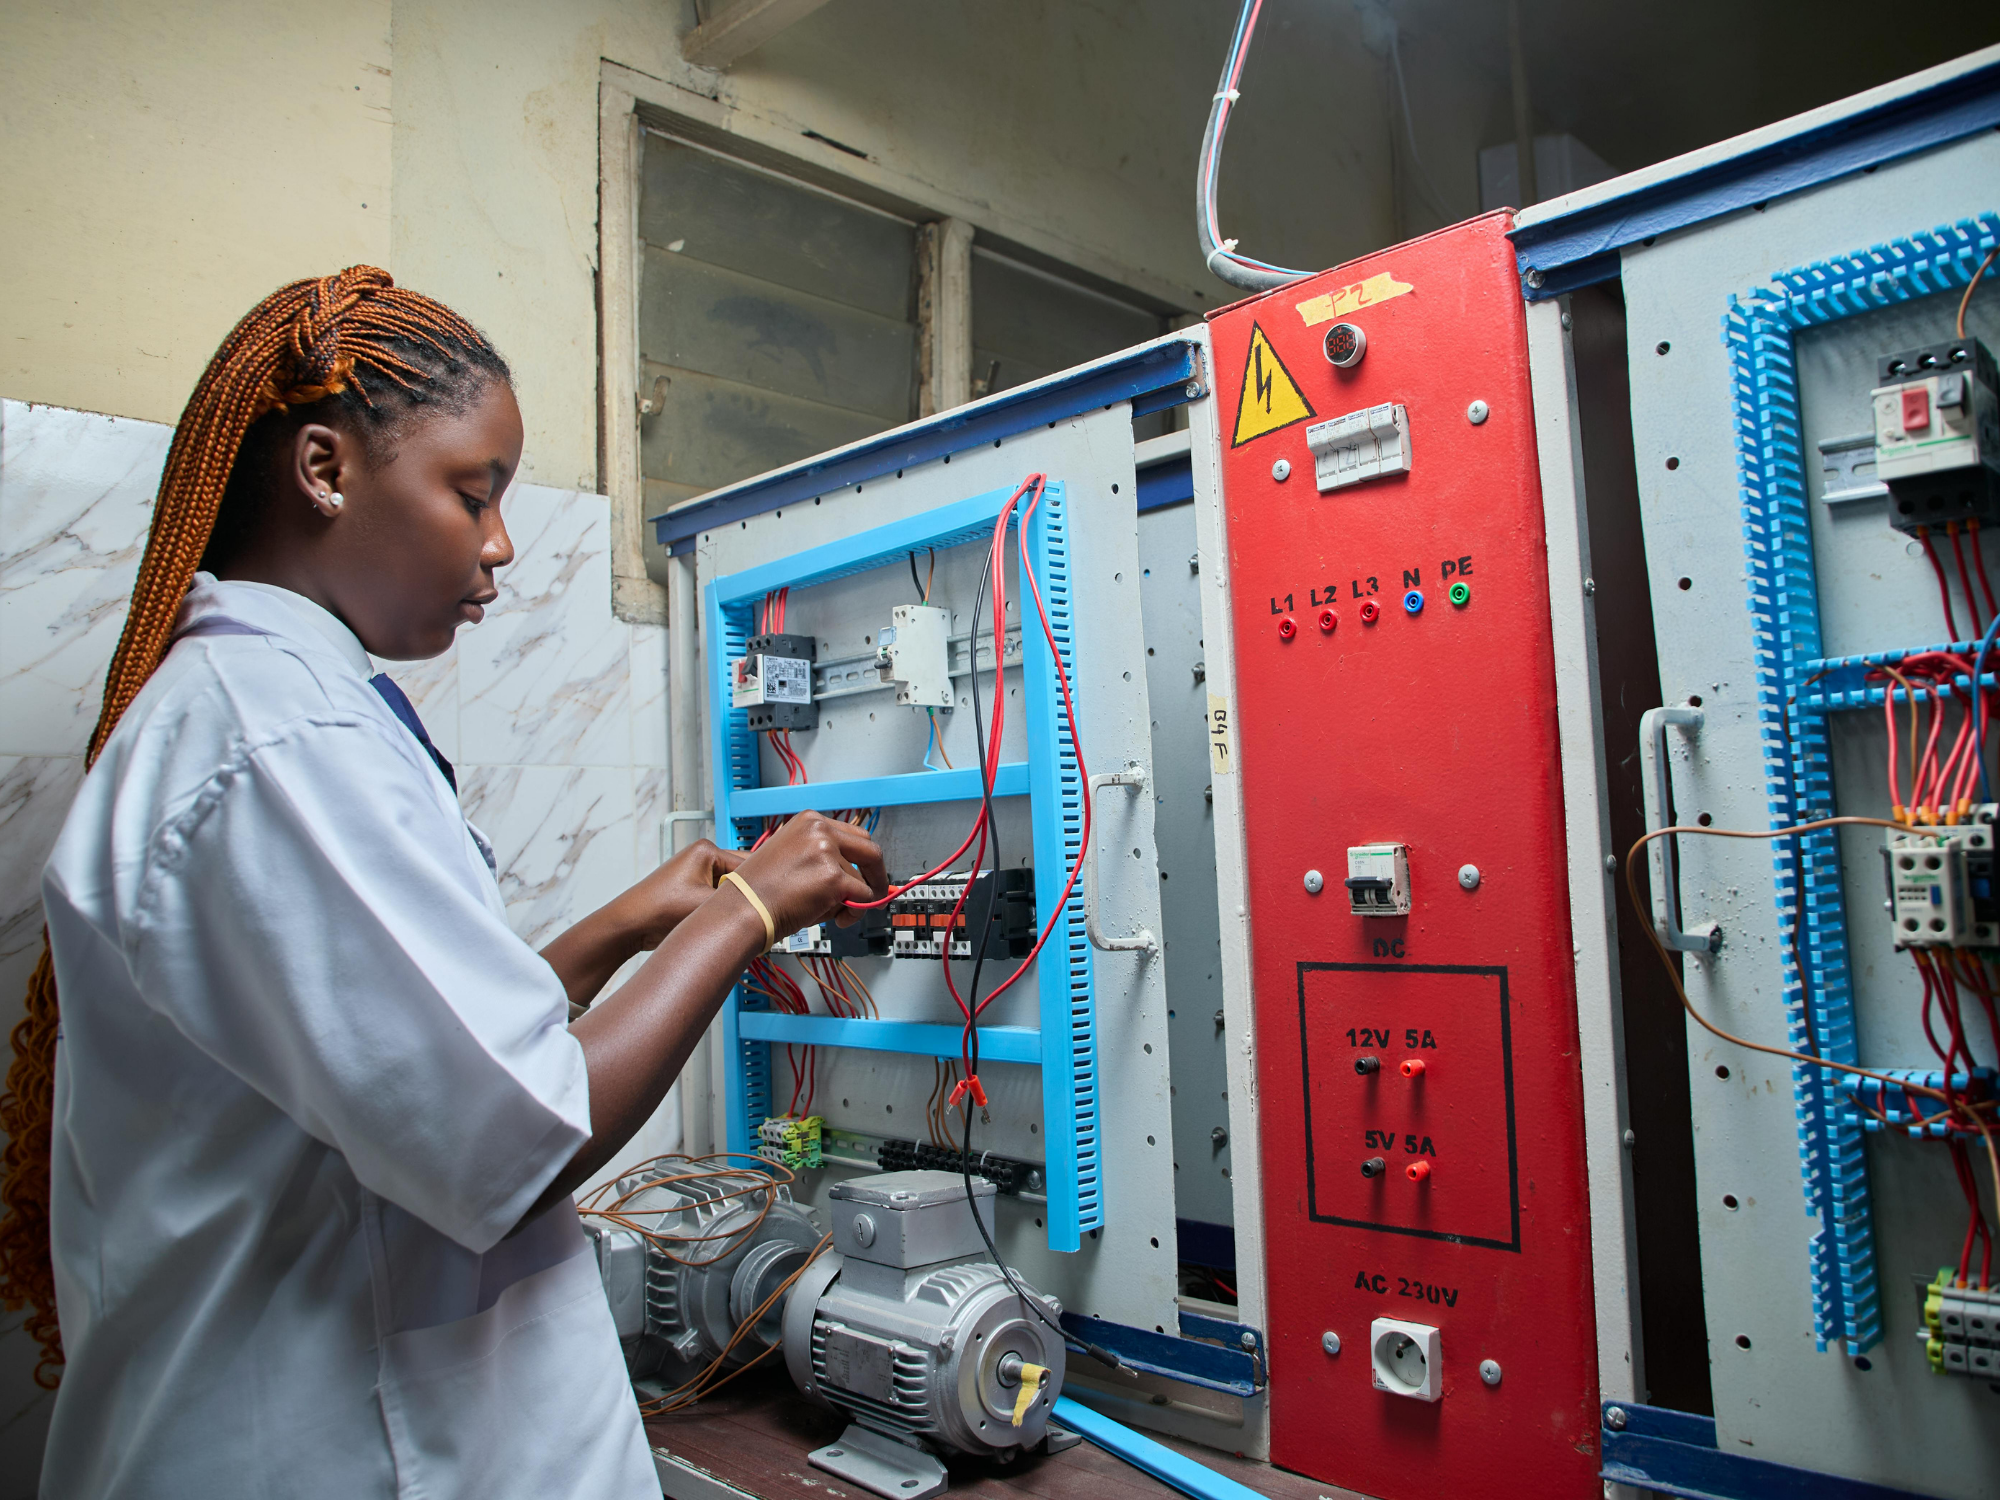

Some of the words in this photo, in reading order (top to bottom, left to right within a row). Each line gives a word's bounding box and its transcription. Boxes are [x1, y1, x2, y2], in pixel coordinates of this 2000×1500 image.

[1270, 593, 1294, 615] L1
[1310, 585, 1337, 607] L2
[1352, 576, 1379, 599] L3
[1403, 568, 1420, 589] N
[1441, 555, 1474, 580] PE
[1373, 938, 1406, 958] DC
[1346, 1028, 1390, 1049] 12V
[1405, 1028, 1437, 1049] 5A
[1365, 1130, 1396, 1151] 5V
[1404, 1134, 1437, 1157] 5A
[1354, 1271, 1388, 1295] AC
[1398, 1277, 1459, 1308] 230V
